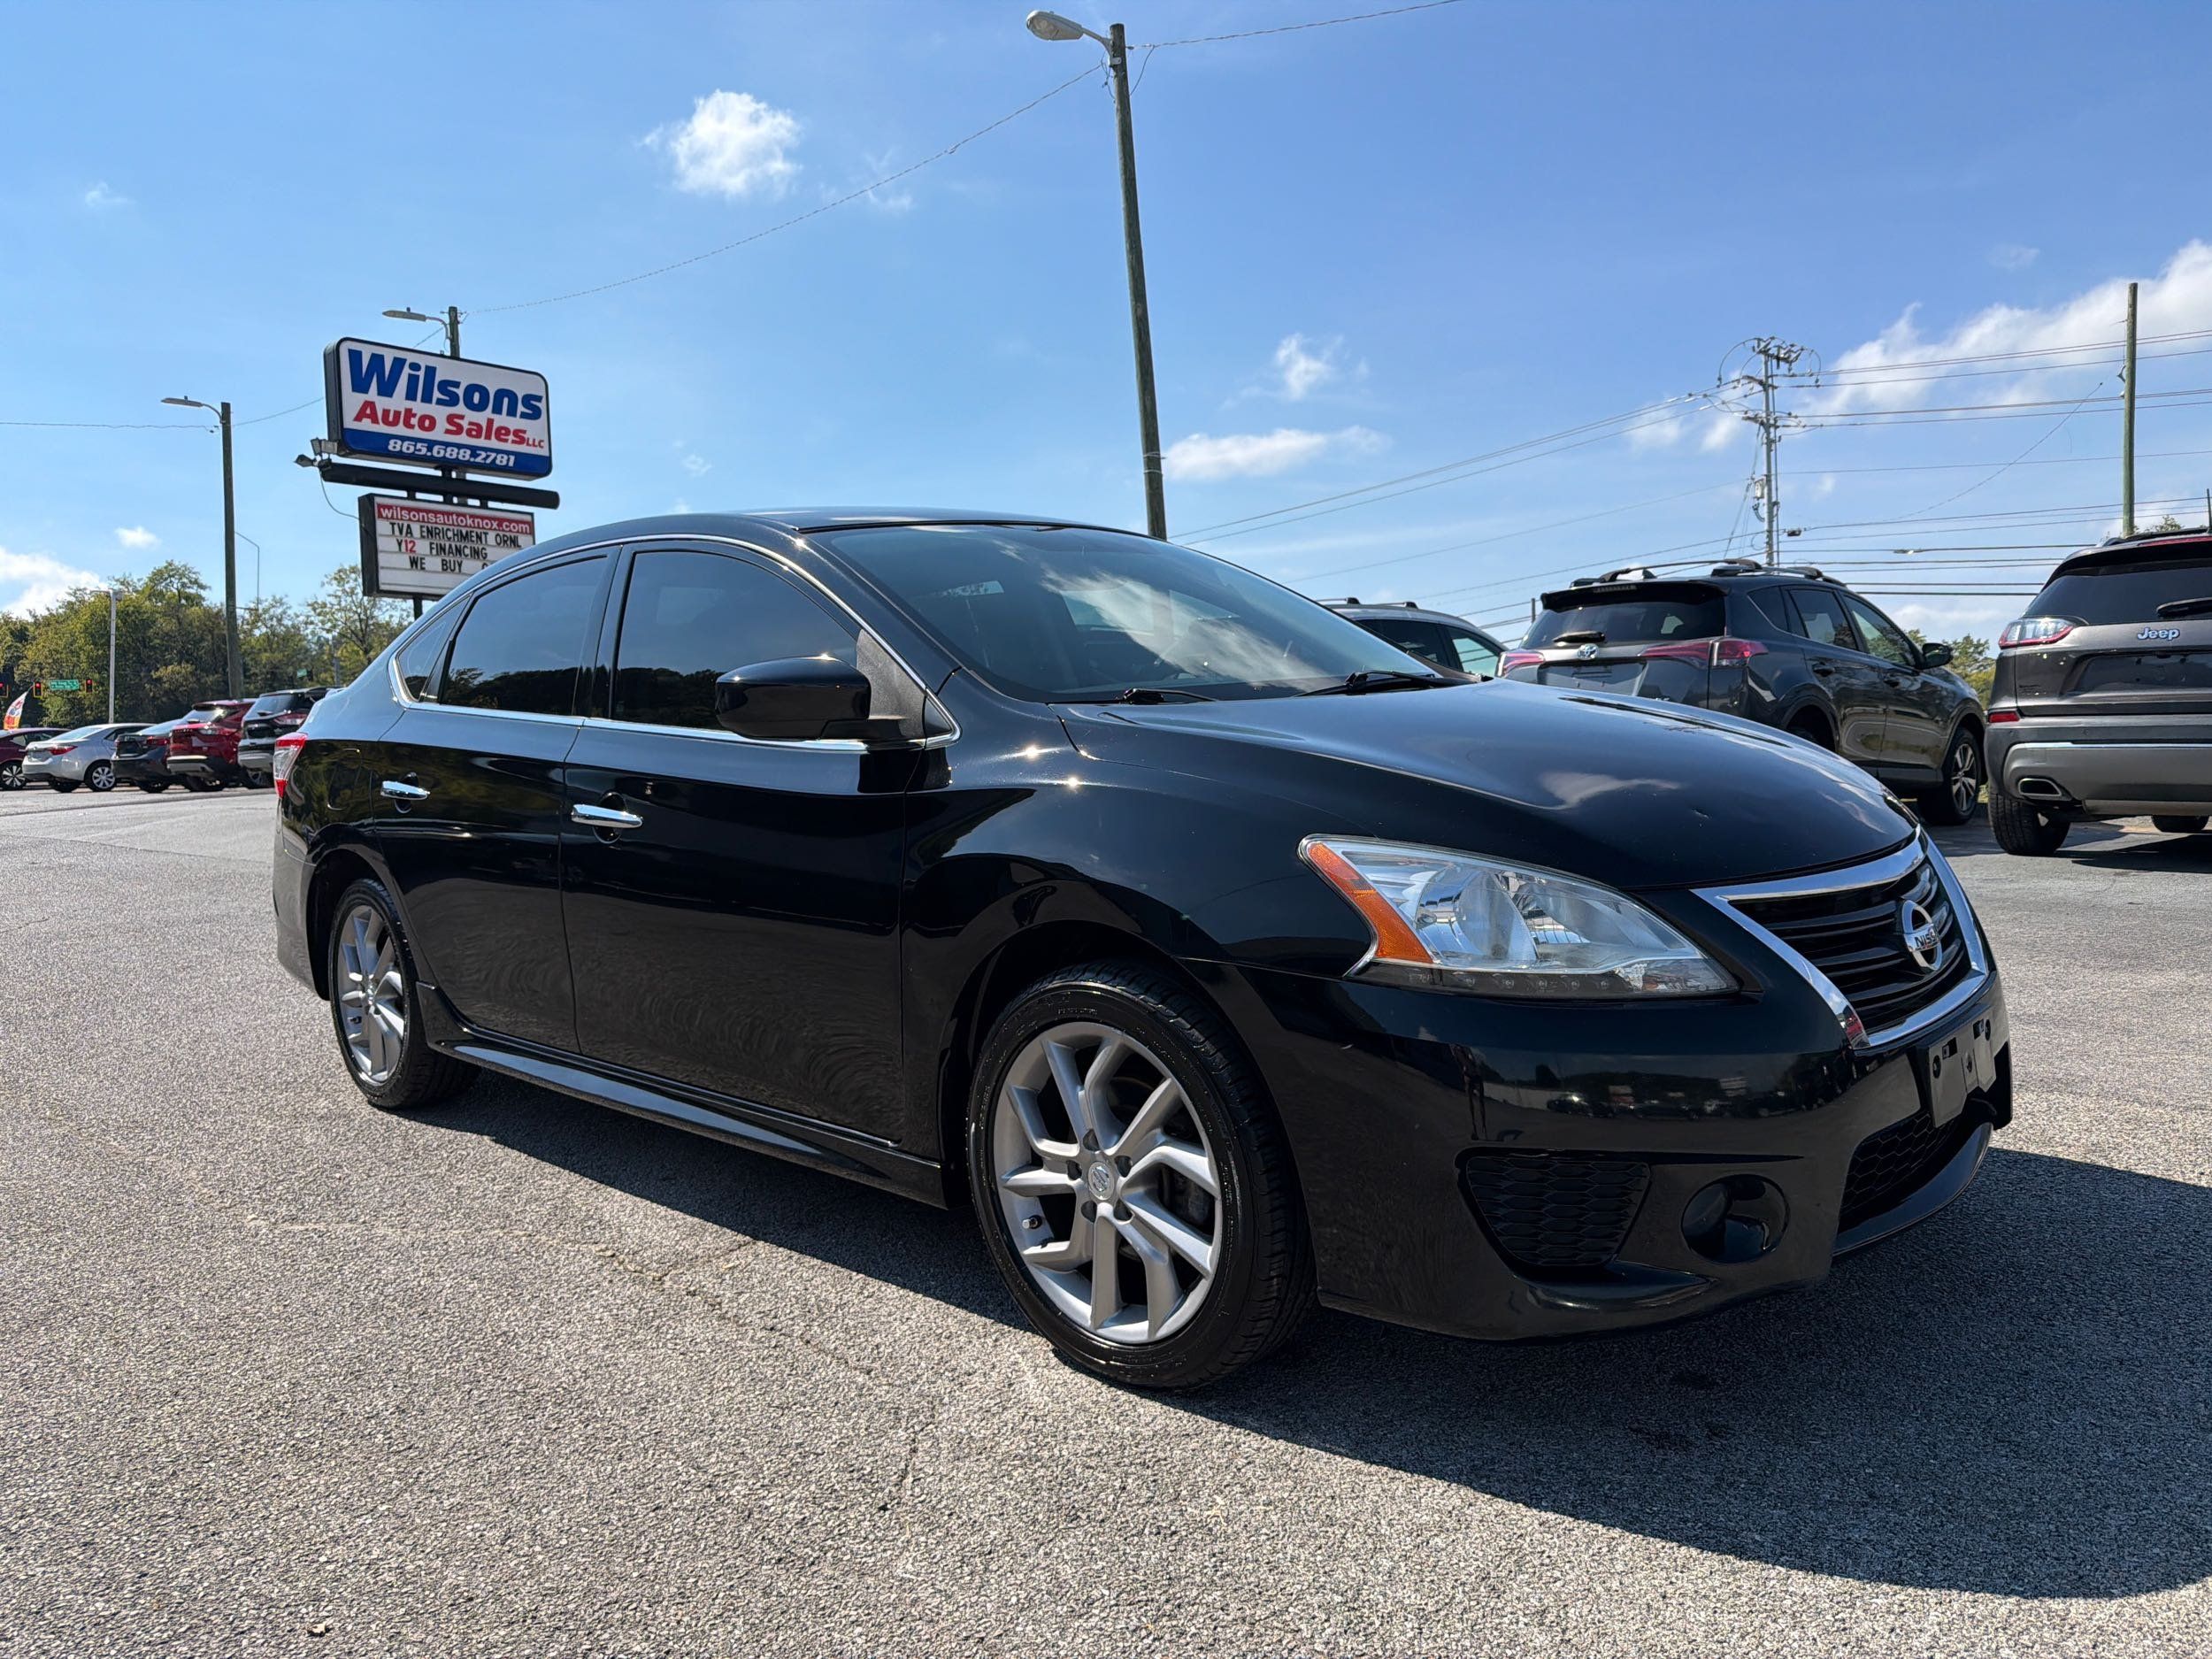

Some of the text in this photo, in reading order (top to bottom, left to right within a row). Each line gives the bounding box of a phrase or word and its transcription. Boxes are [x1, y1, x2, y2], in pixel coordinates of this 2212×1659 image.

[348, 349, 543, 420] Wilsons
[353, 400, 544, 449] Auto Sales LLC
[388, 439, 516, 467] 865.688.2781
[380, 507, 530, 534] wilsonsautoknox.com
[389, 522, 522, 549] TVA ENRICHMENT ORNL
[396, 538, 488, 560] Y12 FINANCING
[409, 556, 426, 571] WE
[442, 558, 464, 573] BUY
[2137, 627, 2180, 641] Jeep
